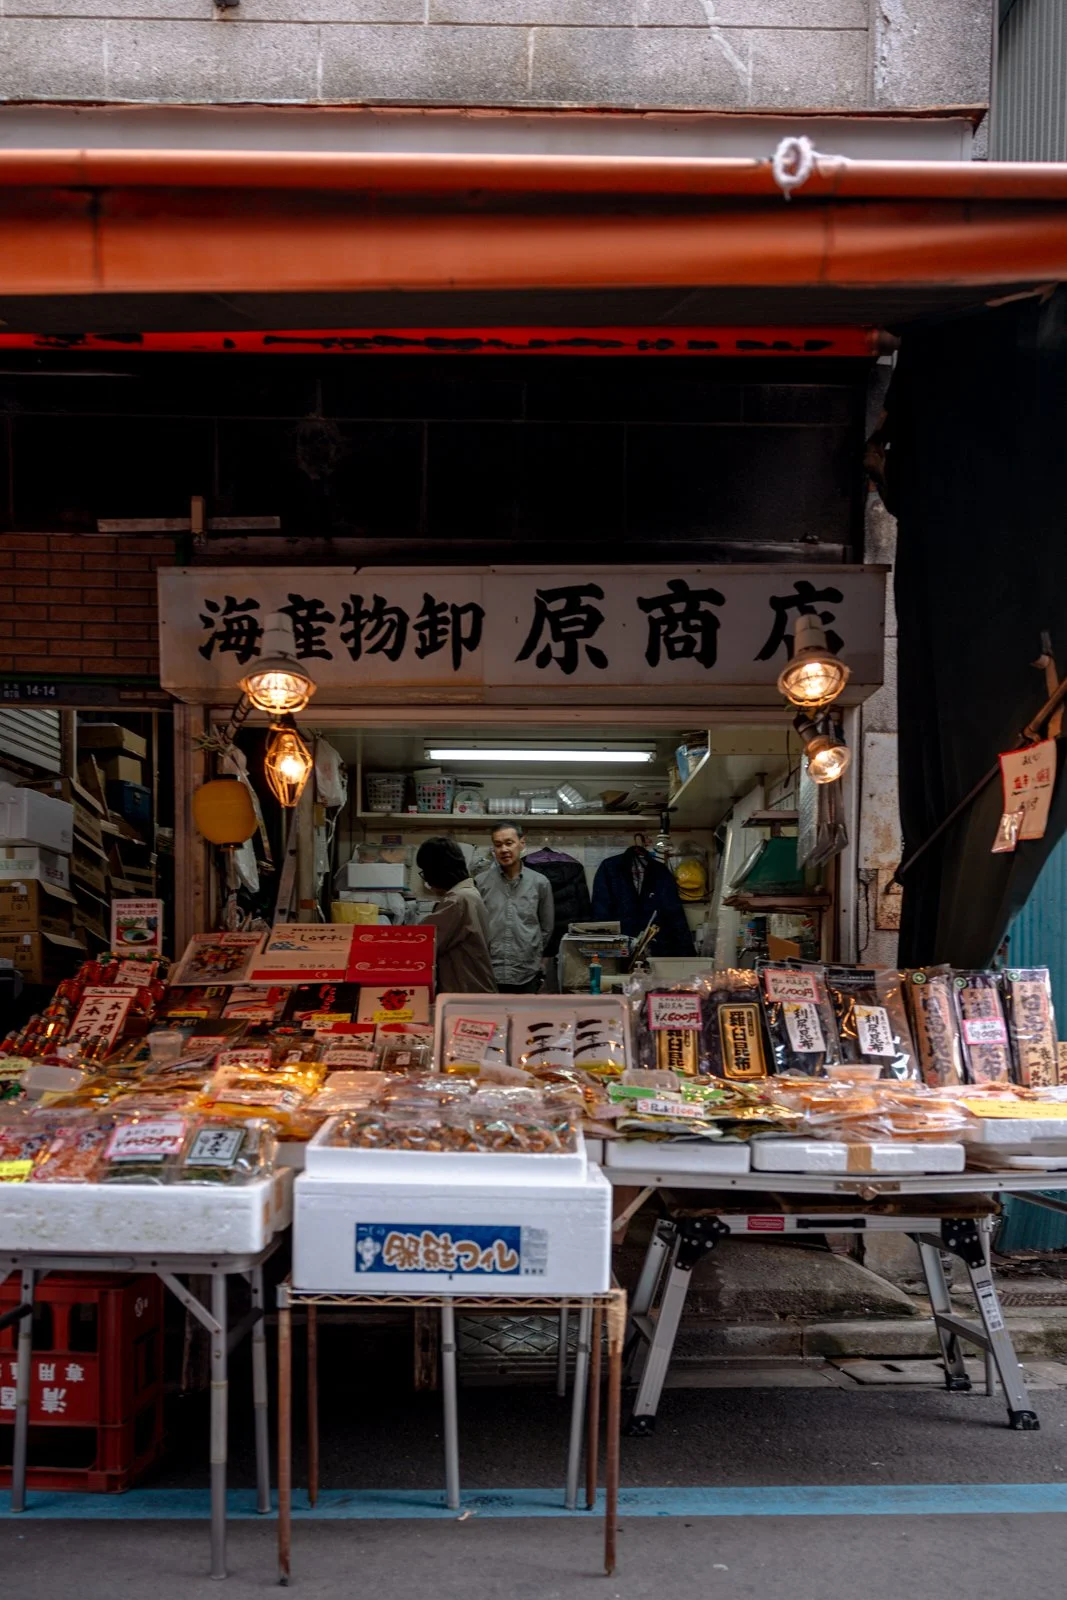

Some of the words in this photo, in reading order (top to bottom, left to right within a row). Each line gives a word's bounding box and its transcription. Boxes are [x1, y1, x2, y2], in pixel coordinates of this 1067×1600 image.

[198, 591, 485, 671] 海産物卸
[25, 683, 57, 697] 14-14
[729, 1010, 751, 1071] 羅臼昆布
[794, 1008, 814, 1050] 利尻昆布
[865, 1014, 885, 1053] 利尻昆布
